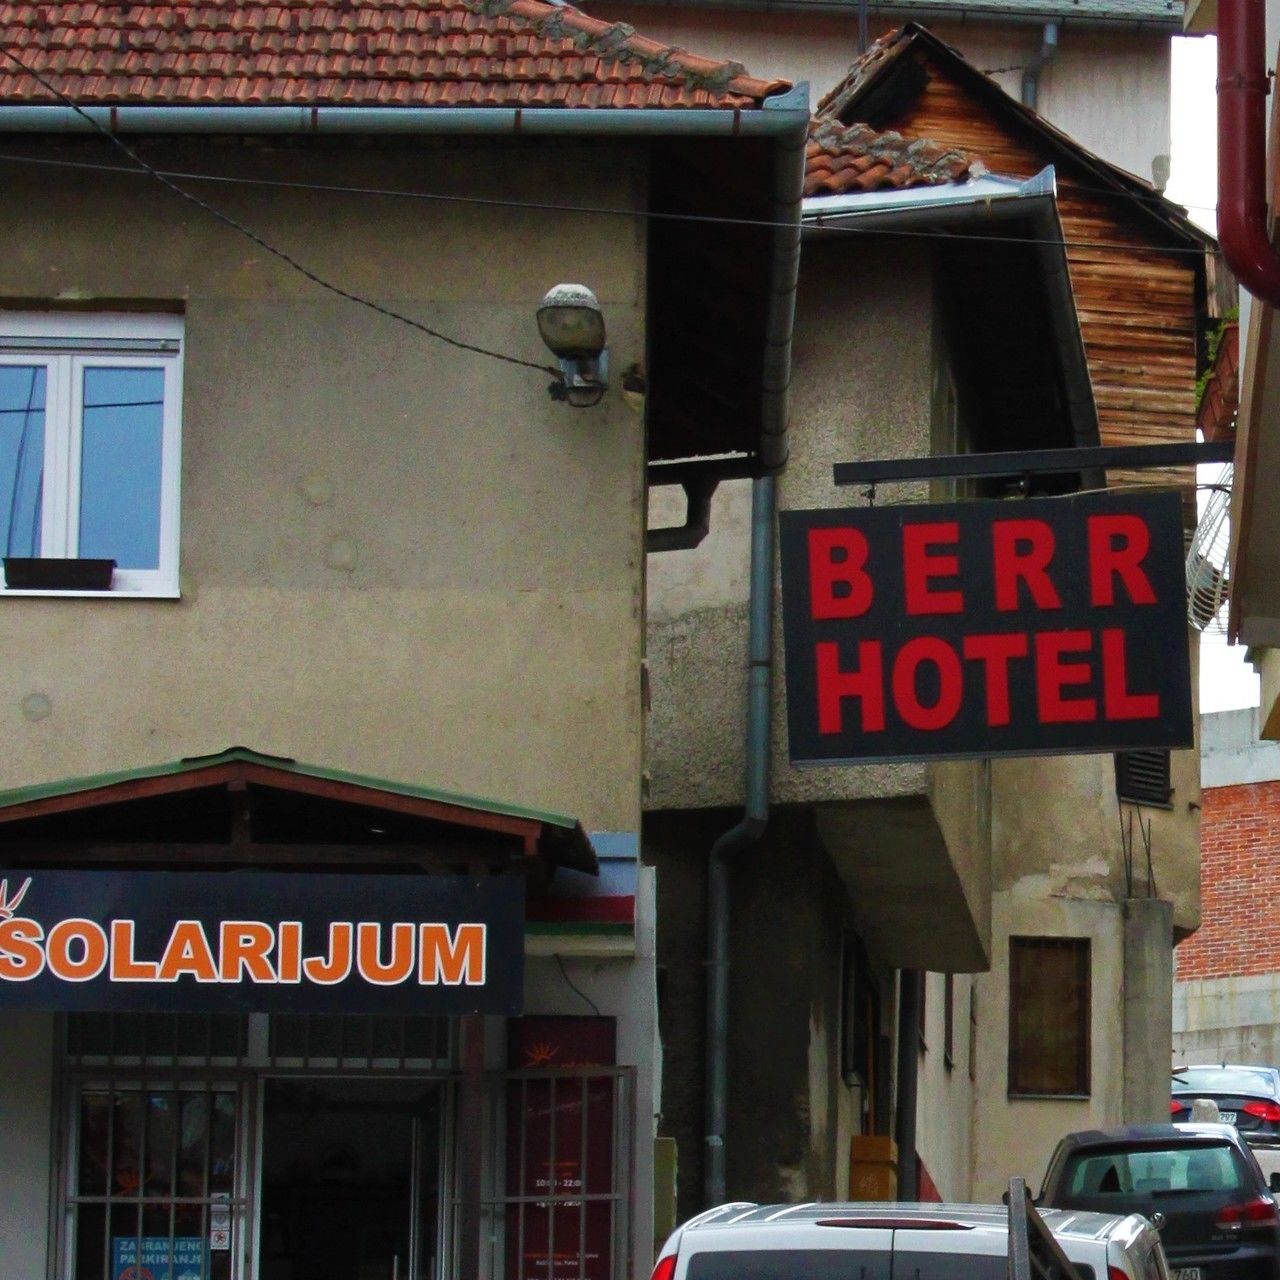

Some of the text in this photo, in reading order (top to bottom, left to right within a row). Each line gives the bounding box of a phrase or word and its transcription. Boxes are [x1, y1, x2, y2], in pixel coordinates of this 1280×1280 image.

[807, 513, 1157, 620] BERR
[814, 628, 1160, 734] HOTEL
[0, 917, 487, 985] SOLARIJUM
